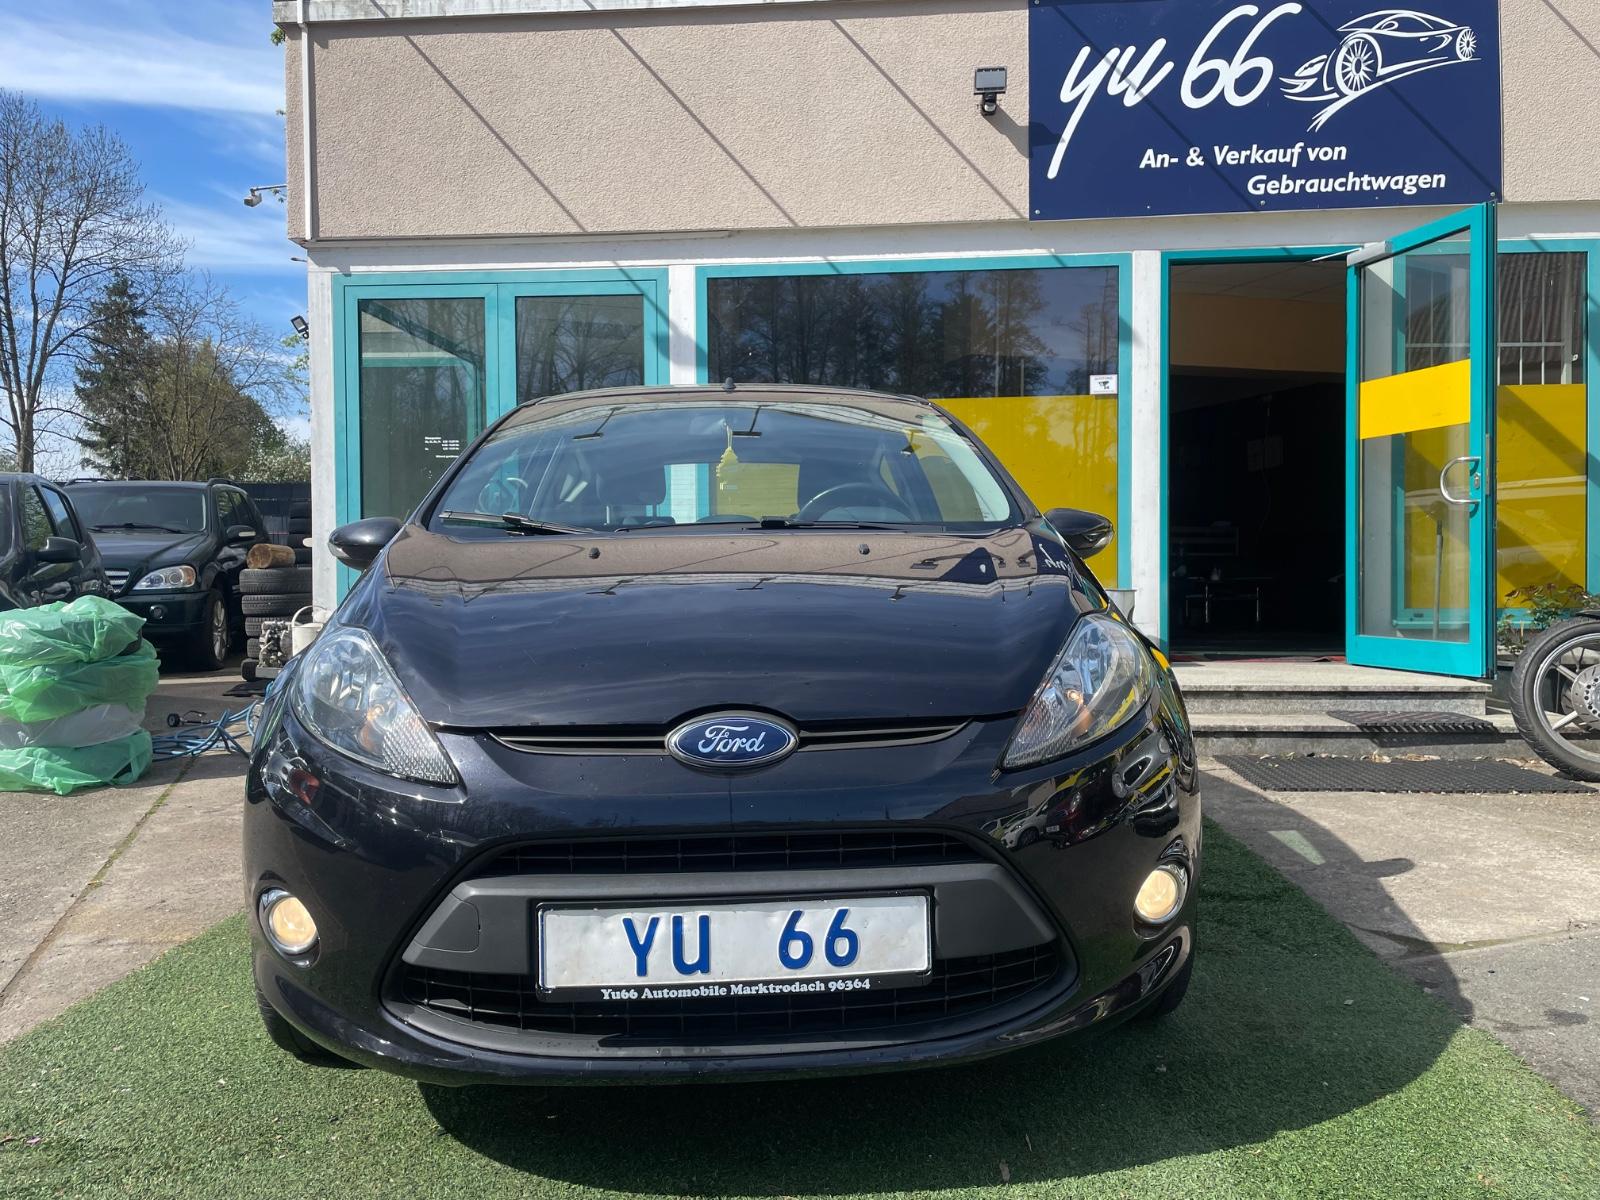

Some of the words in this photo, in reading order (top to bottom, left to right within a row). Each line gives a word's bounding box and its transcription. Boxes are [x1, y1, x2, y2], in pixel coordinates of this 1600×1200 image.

[1180, 2, 1302, 110] 66
[1139, 147, 1179, 169] An-
[1186, 146, 1205, 167] &
[1213, 142, 1304, 167] Verkauf
[1307, 144, 1347, 162] von
[1246, 172, 1447, 196] Gebrauchtwagen
[697, 725, 766, 753] Ford
[621, 914, 710, 977] YU
[777, 908, 860, 971] 66
[601, 988, 639, 1000] Yu66
[641, 985, 728, 1000] Automobile
[730, 980, 826, 996] Marktrodach
[828, 978, 872, 992] 96364
